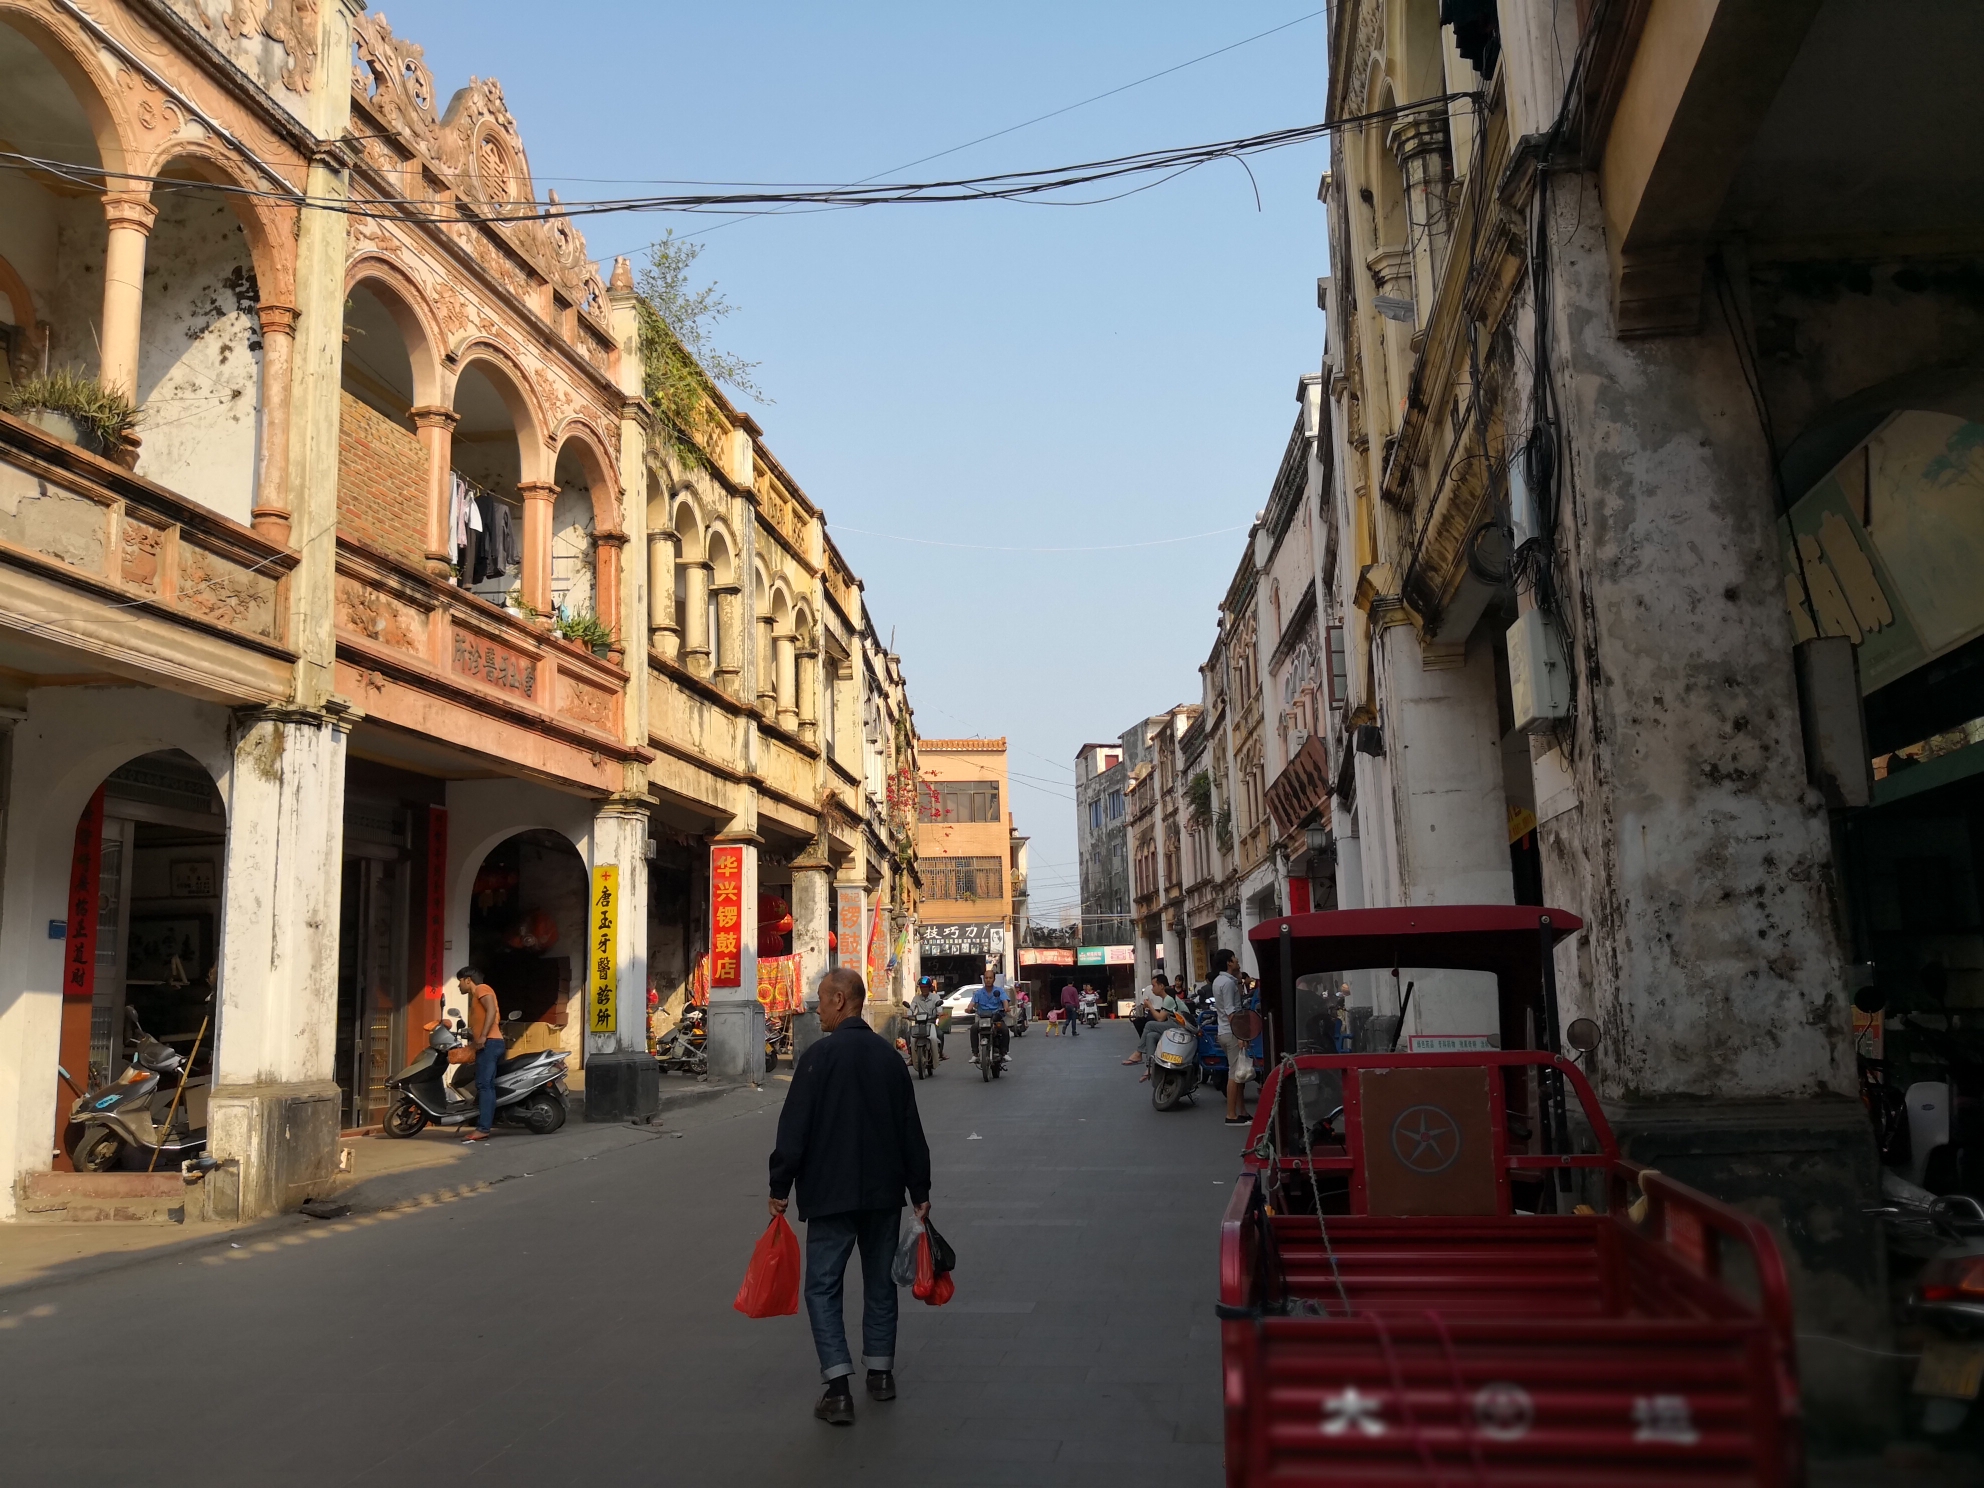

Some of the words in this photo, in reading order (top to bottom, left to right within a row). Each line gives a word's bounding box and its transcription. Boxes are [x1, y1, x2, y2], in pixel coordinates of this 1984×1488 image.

[715, 855, 738, 979] 华兴锣鼓店
[1319, 1386, 1389, 1436] 大
